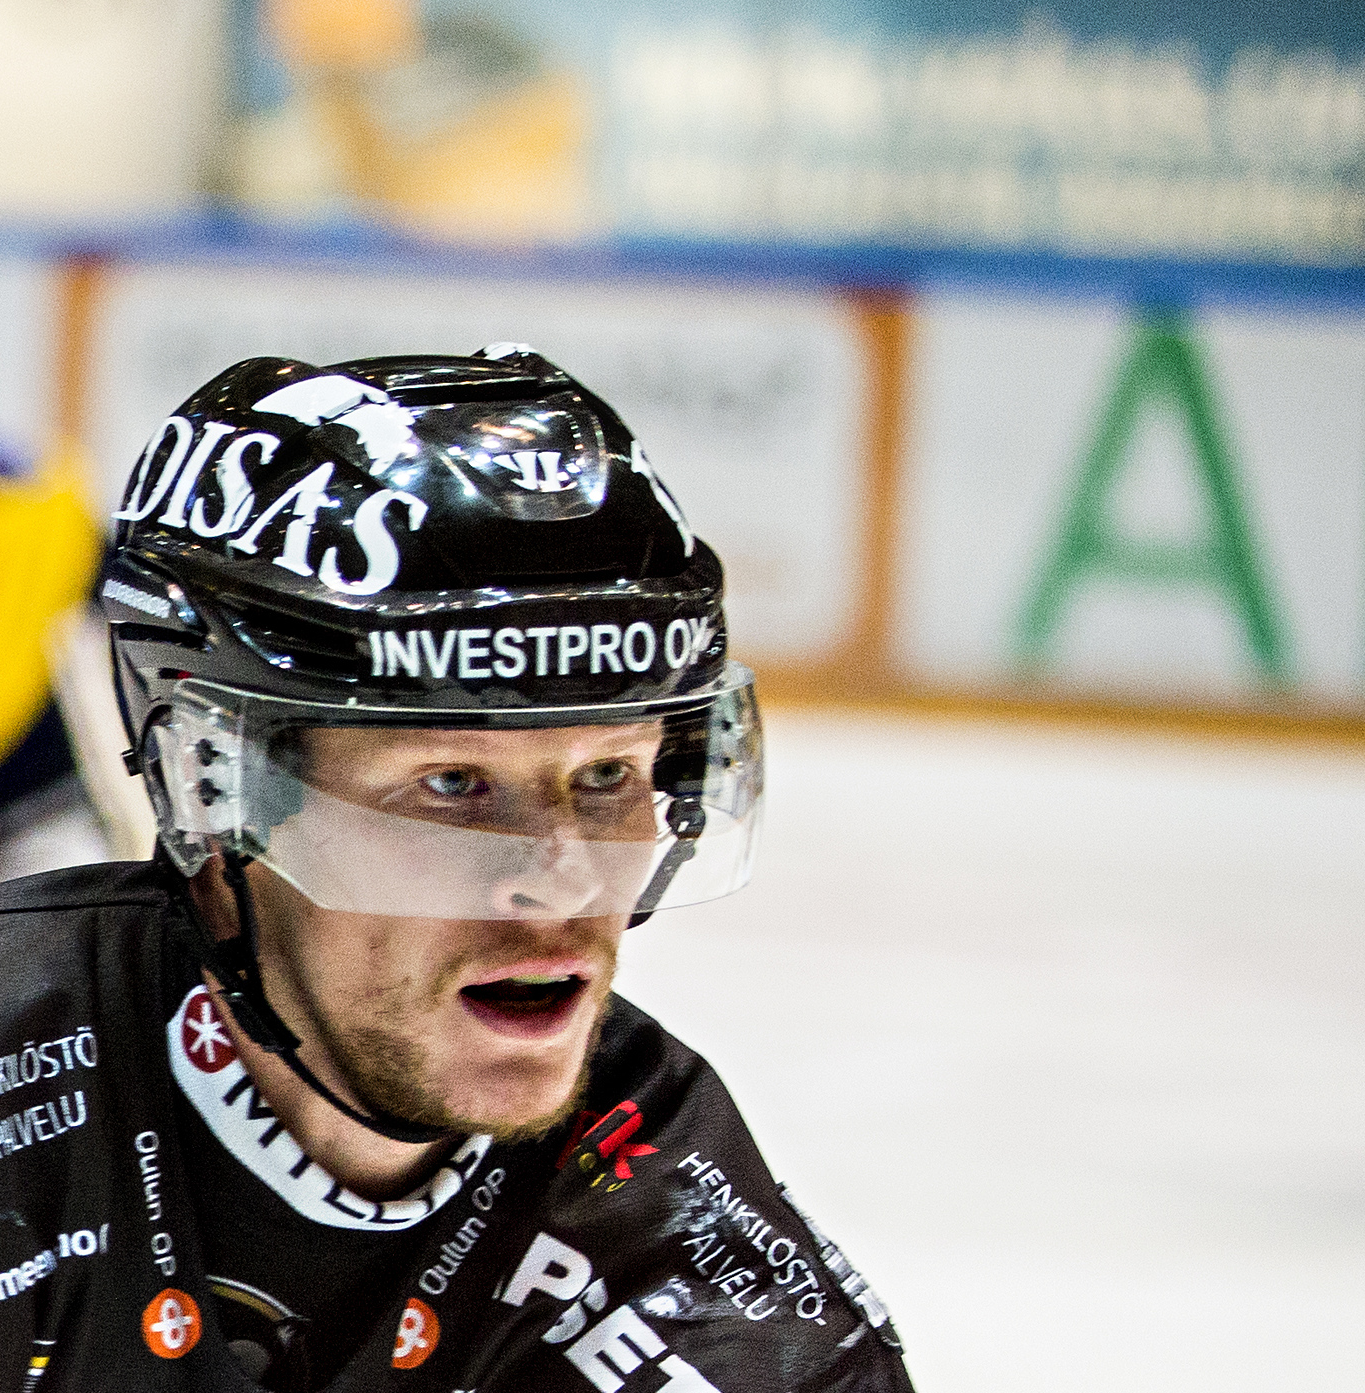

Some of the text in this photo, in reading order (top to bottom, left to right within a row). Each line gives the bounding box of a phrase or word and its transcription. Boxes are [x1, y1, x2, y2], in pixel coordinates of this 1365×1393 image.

[111, 415, 429, 597] DISAS
[370, 622, 656, 681] INVESTPRO
[419, 1168, 507, 1296] Oulun OP
